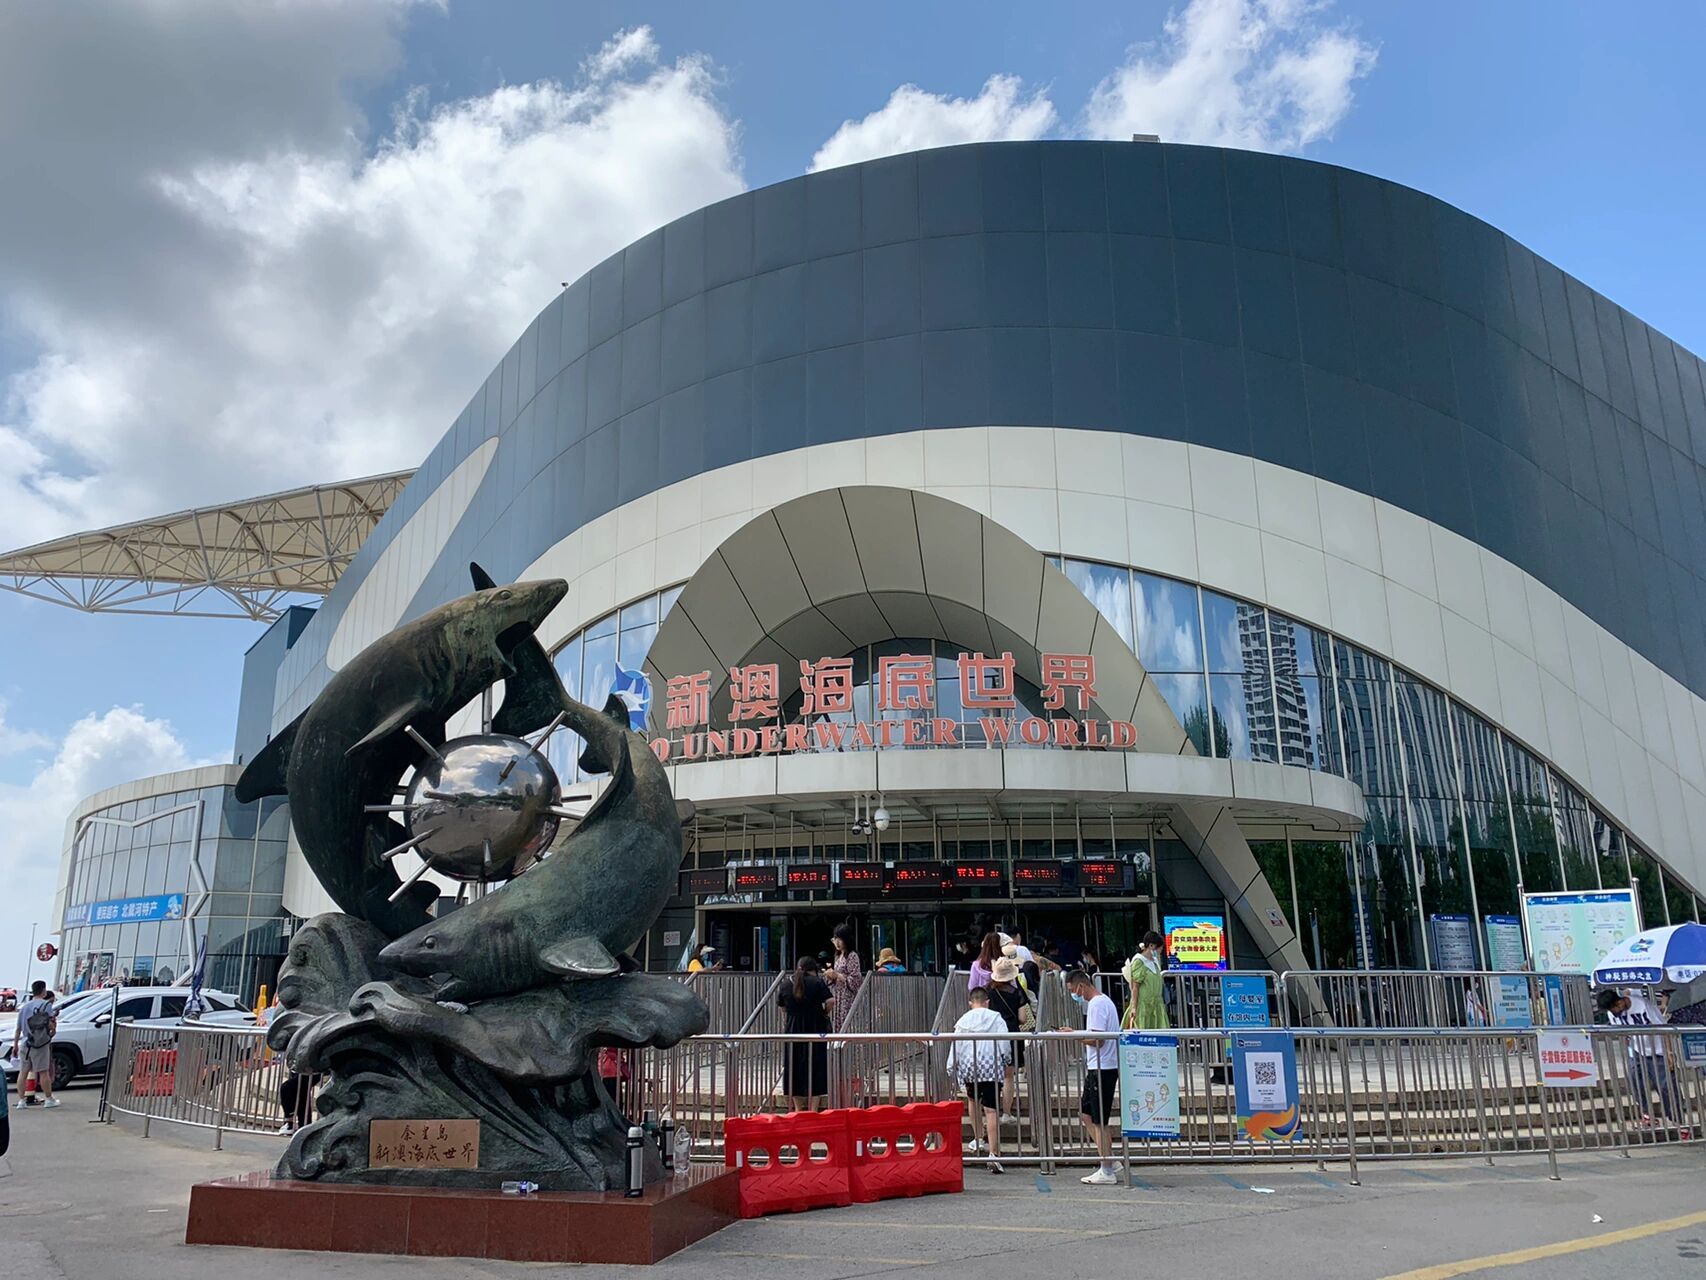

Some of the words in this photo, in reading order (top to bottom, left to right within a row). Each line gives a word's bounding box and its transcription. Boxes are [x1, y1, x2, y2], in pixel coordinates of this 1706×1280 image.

[665, 651, 1097, 729] 新澳海底世界
[683, 717, 958, 759] UNDERWATER
[979, 716, 1138, 747] WORLD
[1541, 1050, 1593, 1064] 学雷锋志愿服务站
[375, 1142, 474, 1163] 新澳海底世界
